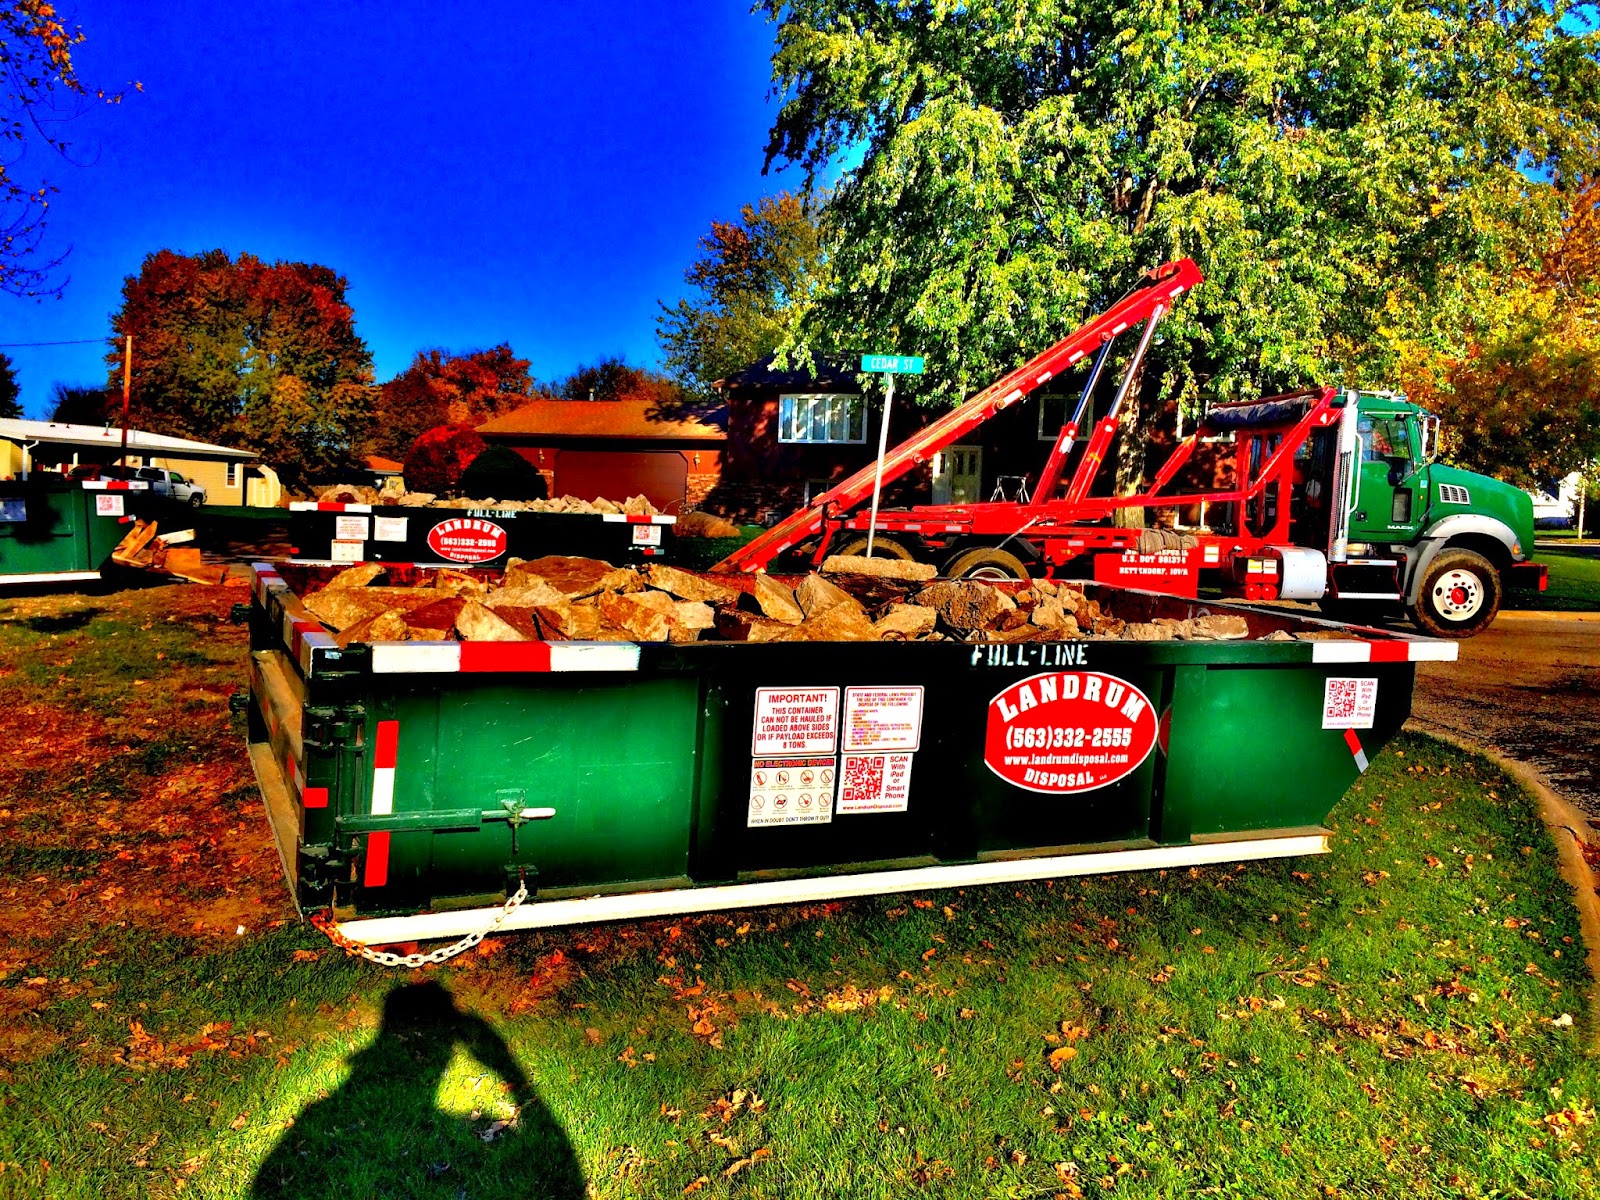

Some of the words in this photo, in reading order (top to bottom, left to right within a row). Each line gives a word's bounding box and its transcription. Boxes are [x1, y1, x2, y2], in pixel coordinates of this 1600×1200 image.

[871, 357, 898, 370] CEDAR
[904, 358, 914, 371] ST
[467, 509, 517, 518] FULL-LINE
[435, 519, 503, 538] LANDRUM
[449, 552, 481, 560] DISPOSAL
[1122, 555, 1137, 563] U.S.
[1139, 555, 1155, 563] DOT
[1170, 568, 1188, 576] IOWA
[971, 644, 1089, 666] FULL-LINE
[769, 694, 827, 703] IMPORTANT!
[996, 674, 1146, 723] LANDRUM
[787, 706, 823, 714] CONTAINER
[790, 715, 798, 723] BE
[811, 723, 829, 731] SIDES
[1006, 725, 1132, 750] (563)332-2555
[754, 760, 764, 768] NO
[765, 759, 806, 767] ELECTRONIC
[1004, 753, 1128, 767] www.landrumdisposal.com
[1024, 768, 1094, 787] DISPOSAL
